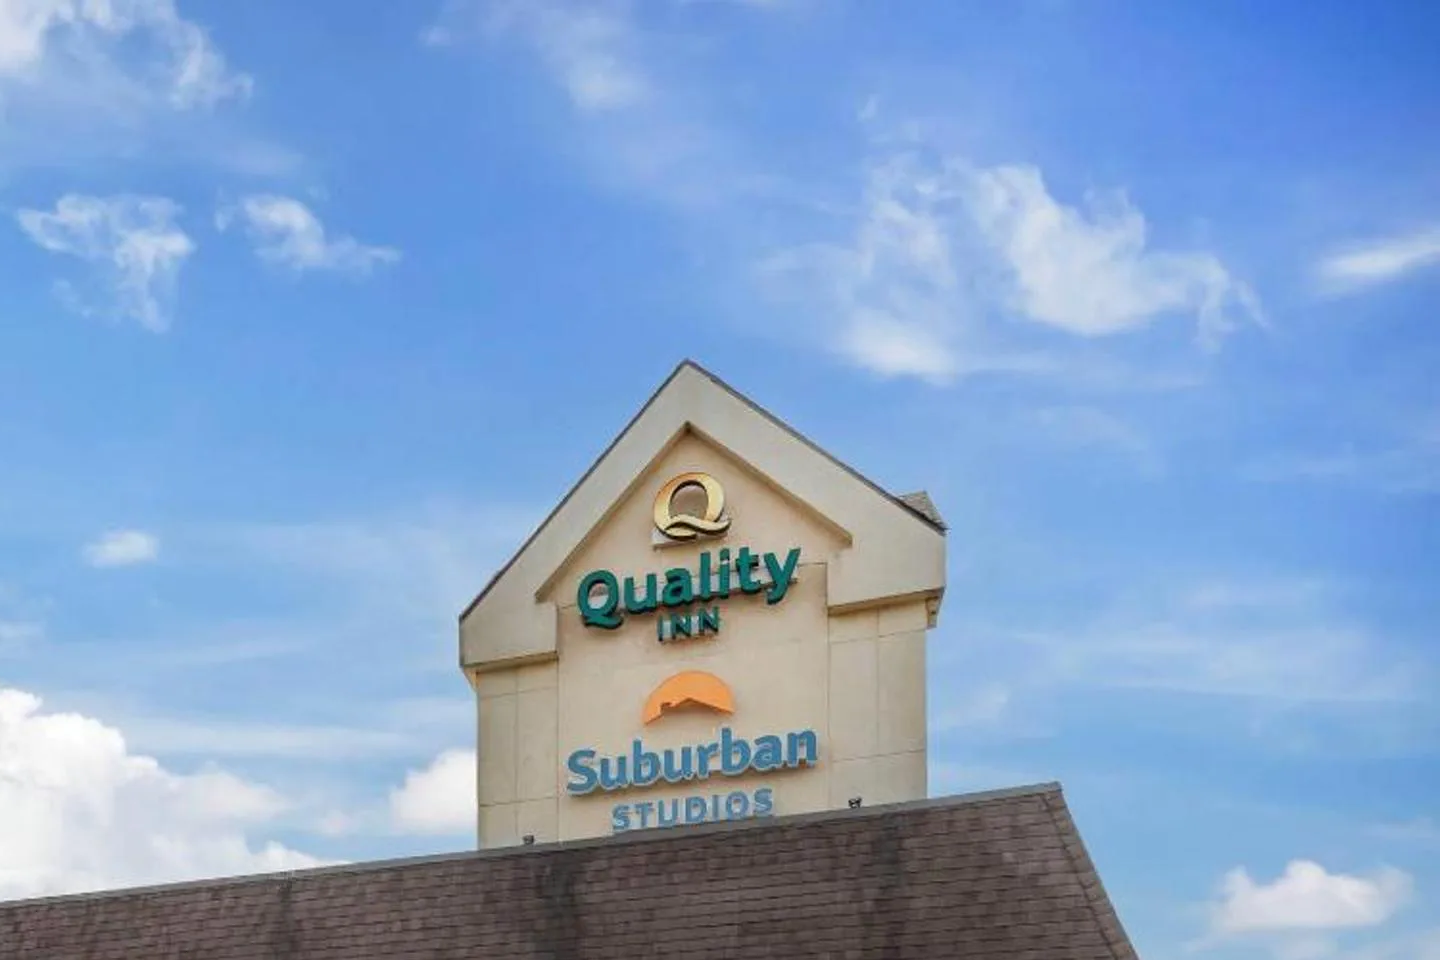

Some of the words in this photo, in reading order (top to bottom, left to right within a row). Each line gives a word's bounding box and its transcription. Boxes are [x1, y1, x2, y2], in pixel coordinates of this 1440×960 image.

[654, 472, 731, 540] Q
[577, 546, 801, 629] Quality
[657, 606, 720, 641] INN
[566, 726, 818, 796] Suburban
[612, 788, 773, 831] STUDIOS
